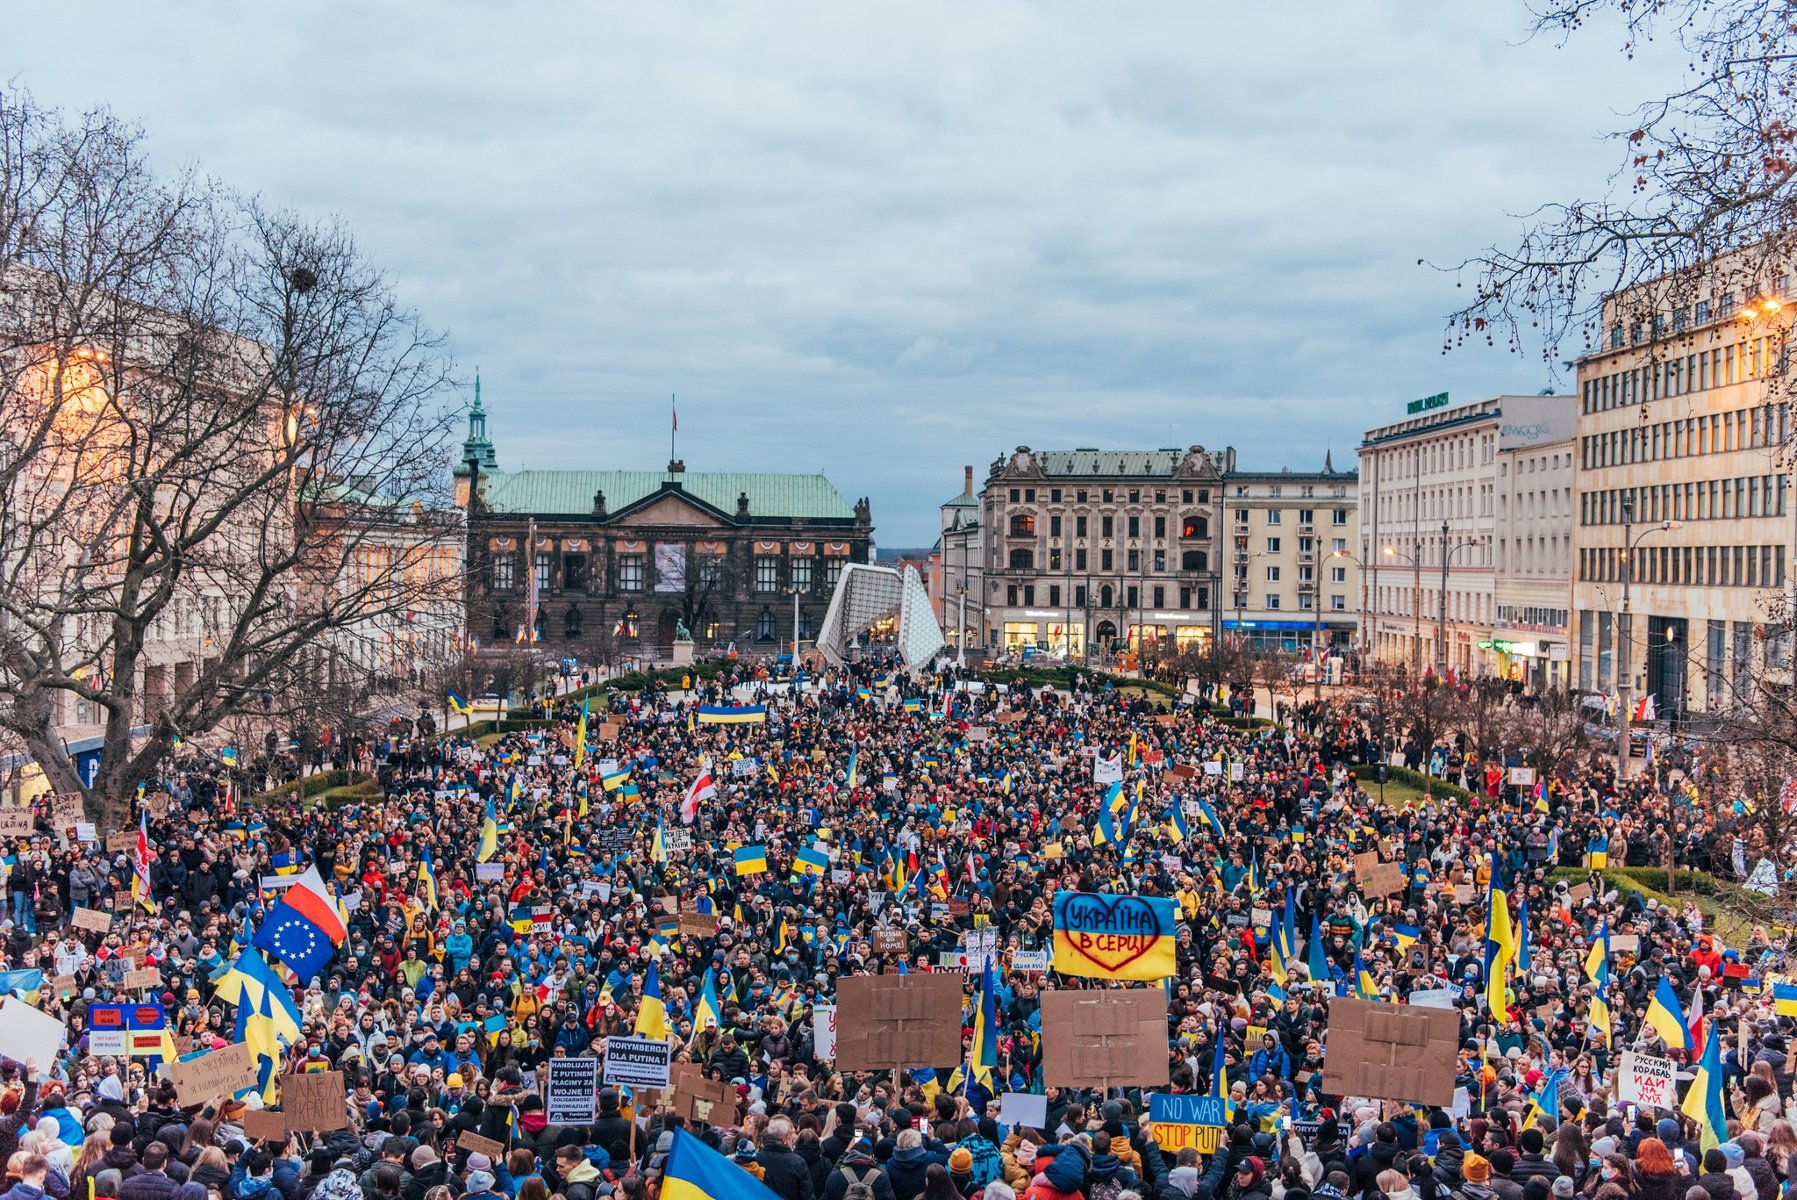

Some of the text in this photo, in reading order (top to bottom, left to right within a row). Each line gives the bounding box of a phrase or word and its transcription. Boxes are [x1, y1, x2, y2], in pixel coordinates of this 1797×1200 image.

[1053, 538, 1163, 548] BAZAR
[1070, 903, 1152, 930] УКРАЇНА
[1080, 930, 1145, 952] В СЕРЦІ
[111, 959, 129, 971] NO
[609, 1041, 668, 1054] NORYMBERGA
[610, 1052, 627, 1061] DLA
[628, 1053, 661, 1064] PUTINA
[1635, 1055, 1671, 1070] РУССКИЙ
[192, 1066, 200, 1075] Я
[1634, 1074, 1665, 1089] ИДИ
[553, 1088, 583, 1096] WOJNĘ
[1642, 1085, 1657, 1094] НА
[1162, 1097, 1221, 1124] NO WAR
[1153, 1124, 1191, 1147] STOP
